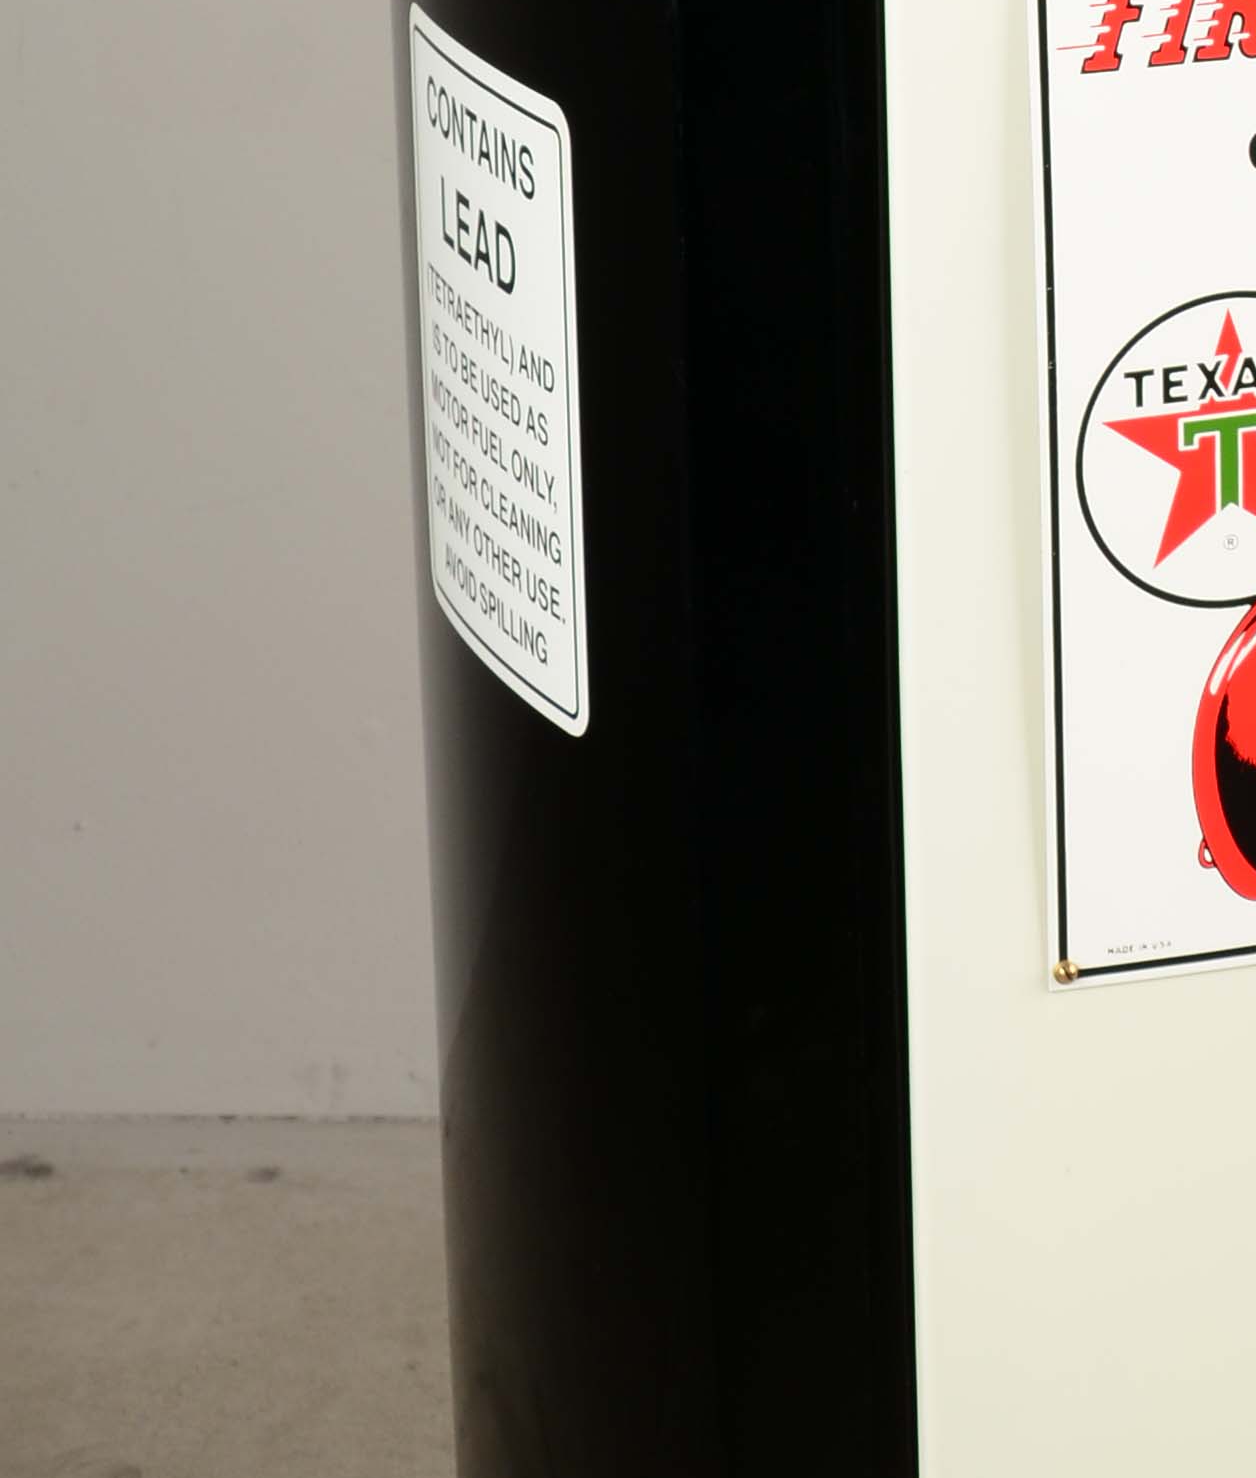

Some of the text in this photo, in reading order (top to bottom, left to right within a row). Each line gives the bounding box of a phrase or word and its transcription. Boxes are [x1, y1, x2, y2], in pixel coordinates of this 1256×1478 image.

[427, 75, 536, 201] CONTAINS
[440, 175, 517, 295] LEAD
[442, 332, 458, 374] TO
[460, 350, 478, 395] BE
[480, 368, 522, 427] USED
[526, 405, 549, 446] AS
[518, 344, 555, 393] AND
[431, 368, 558, 514] MOTOR FUEL ONLY,
[448, 496, 471, 545] ANY
[473, 523, 523, 594] OTHER
[526, 567, 566, 625] USE.
[452, 448, 479, 501] FOR
[480, 477, 562, 567] CLEANING
[445, 542, 548, 666] AVOID SPILLING
